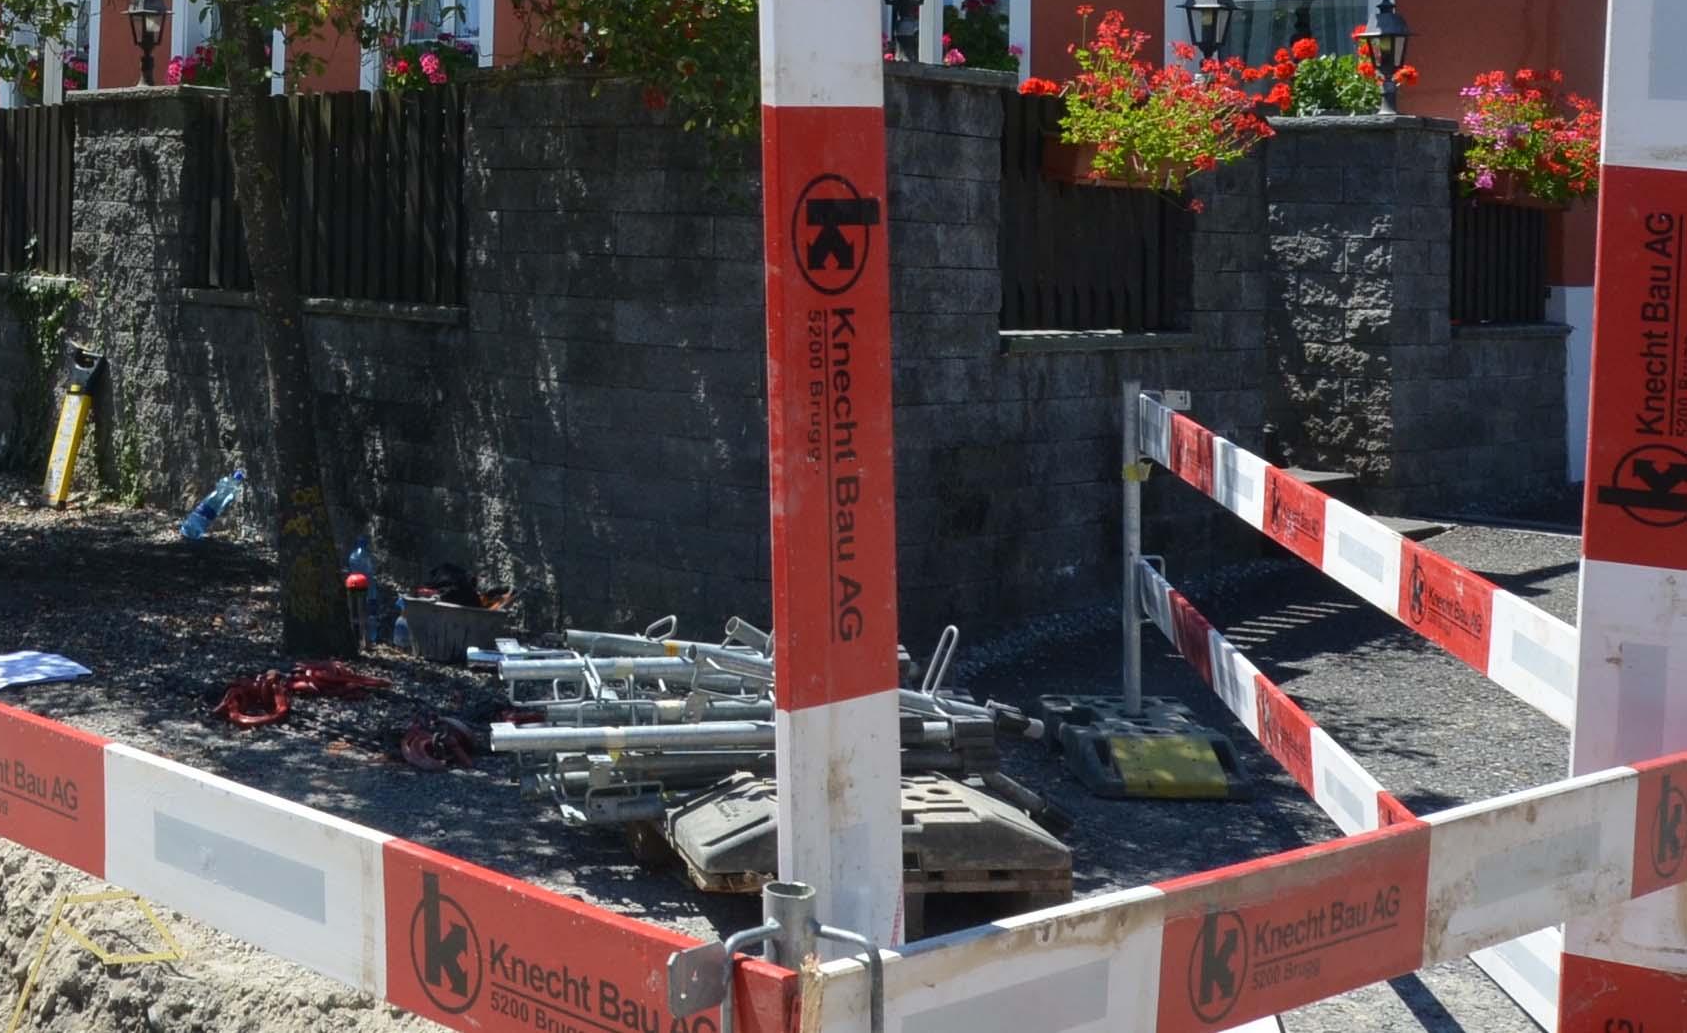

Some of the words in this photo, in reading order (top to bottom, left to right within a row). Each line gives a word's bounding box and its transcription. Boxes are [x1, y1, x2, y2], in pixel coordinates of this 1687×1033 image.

[1645, 212, 1674, 258] AG
[1642, 265, 1672, 323] Bau
[808, 310, 823, 370] 5200
[830, 307, 858, 463] Knecht
[1636, 330, 1669, 436] Knecht
[835, 476, 862, 561] Bau
[837, 577, 864, 643] AG
[14, 761, 47, 800] Bau
[51, 776, 79, 811] AG
[1254, 906, 1327, 956] Knecht
[1330, 901, 1368, 935] Bau
[1370, 885, 1401, 922] AG
[489, 939, 592, 1013] Knecht
[599, 979, 660, 1033] Bau
[490, 991, 529, 1024] 5200
